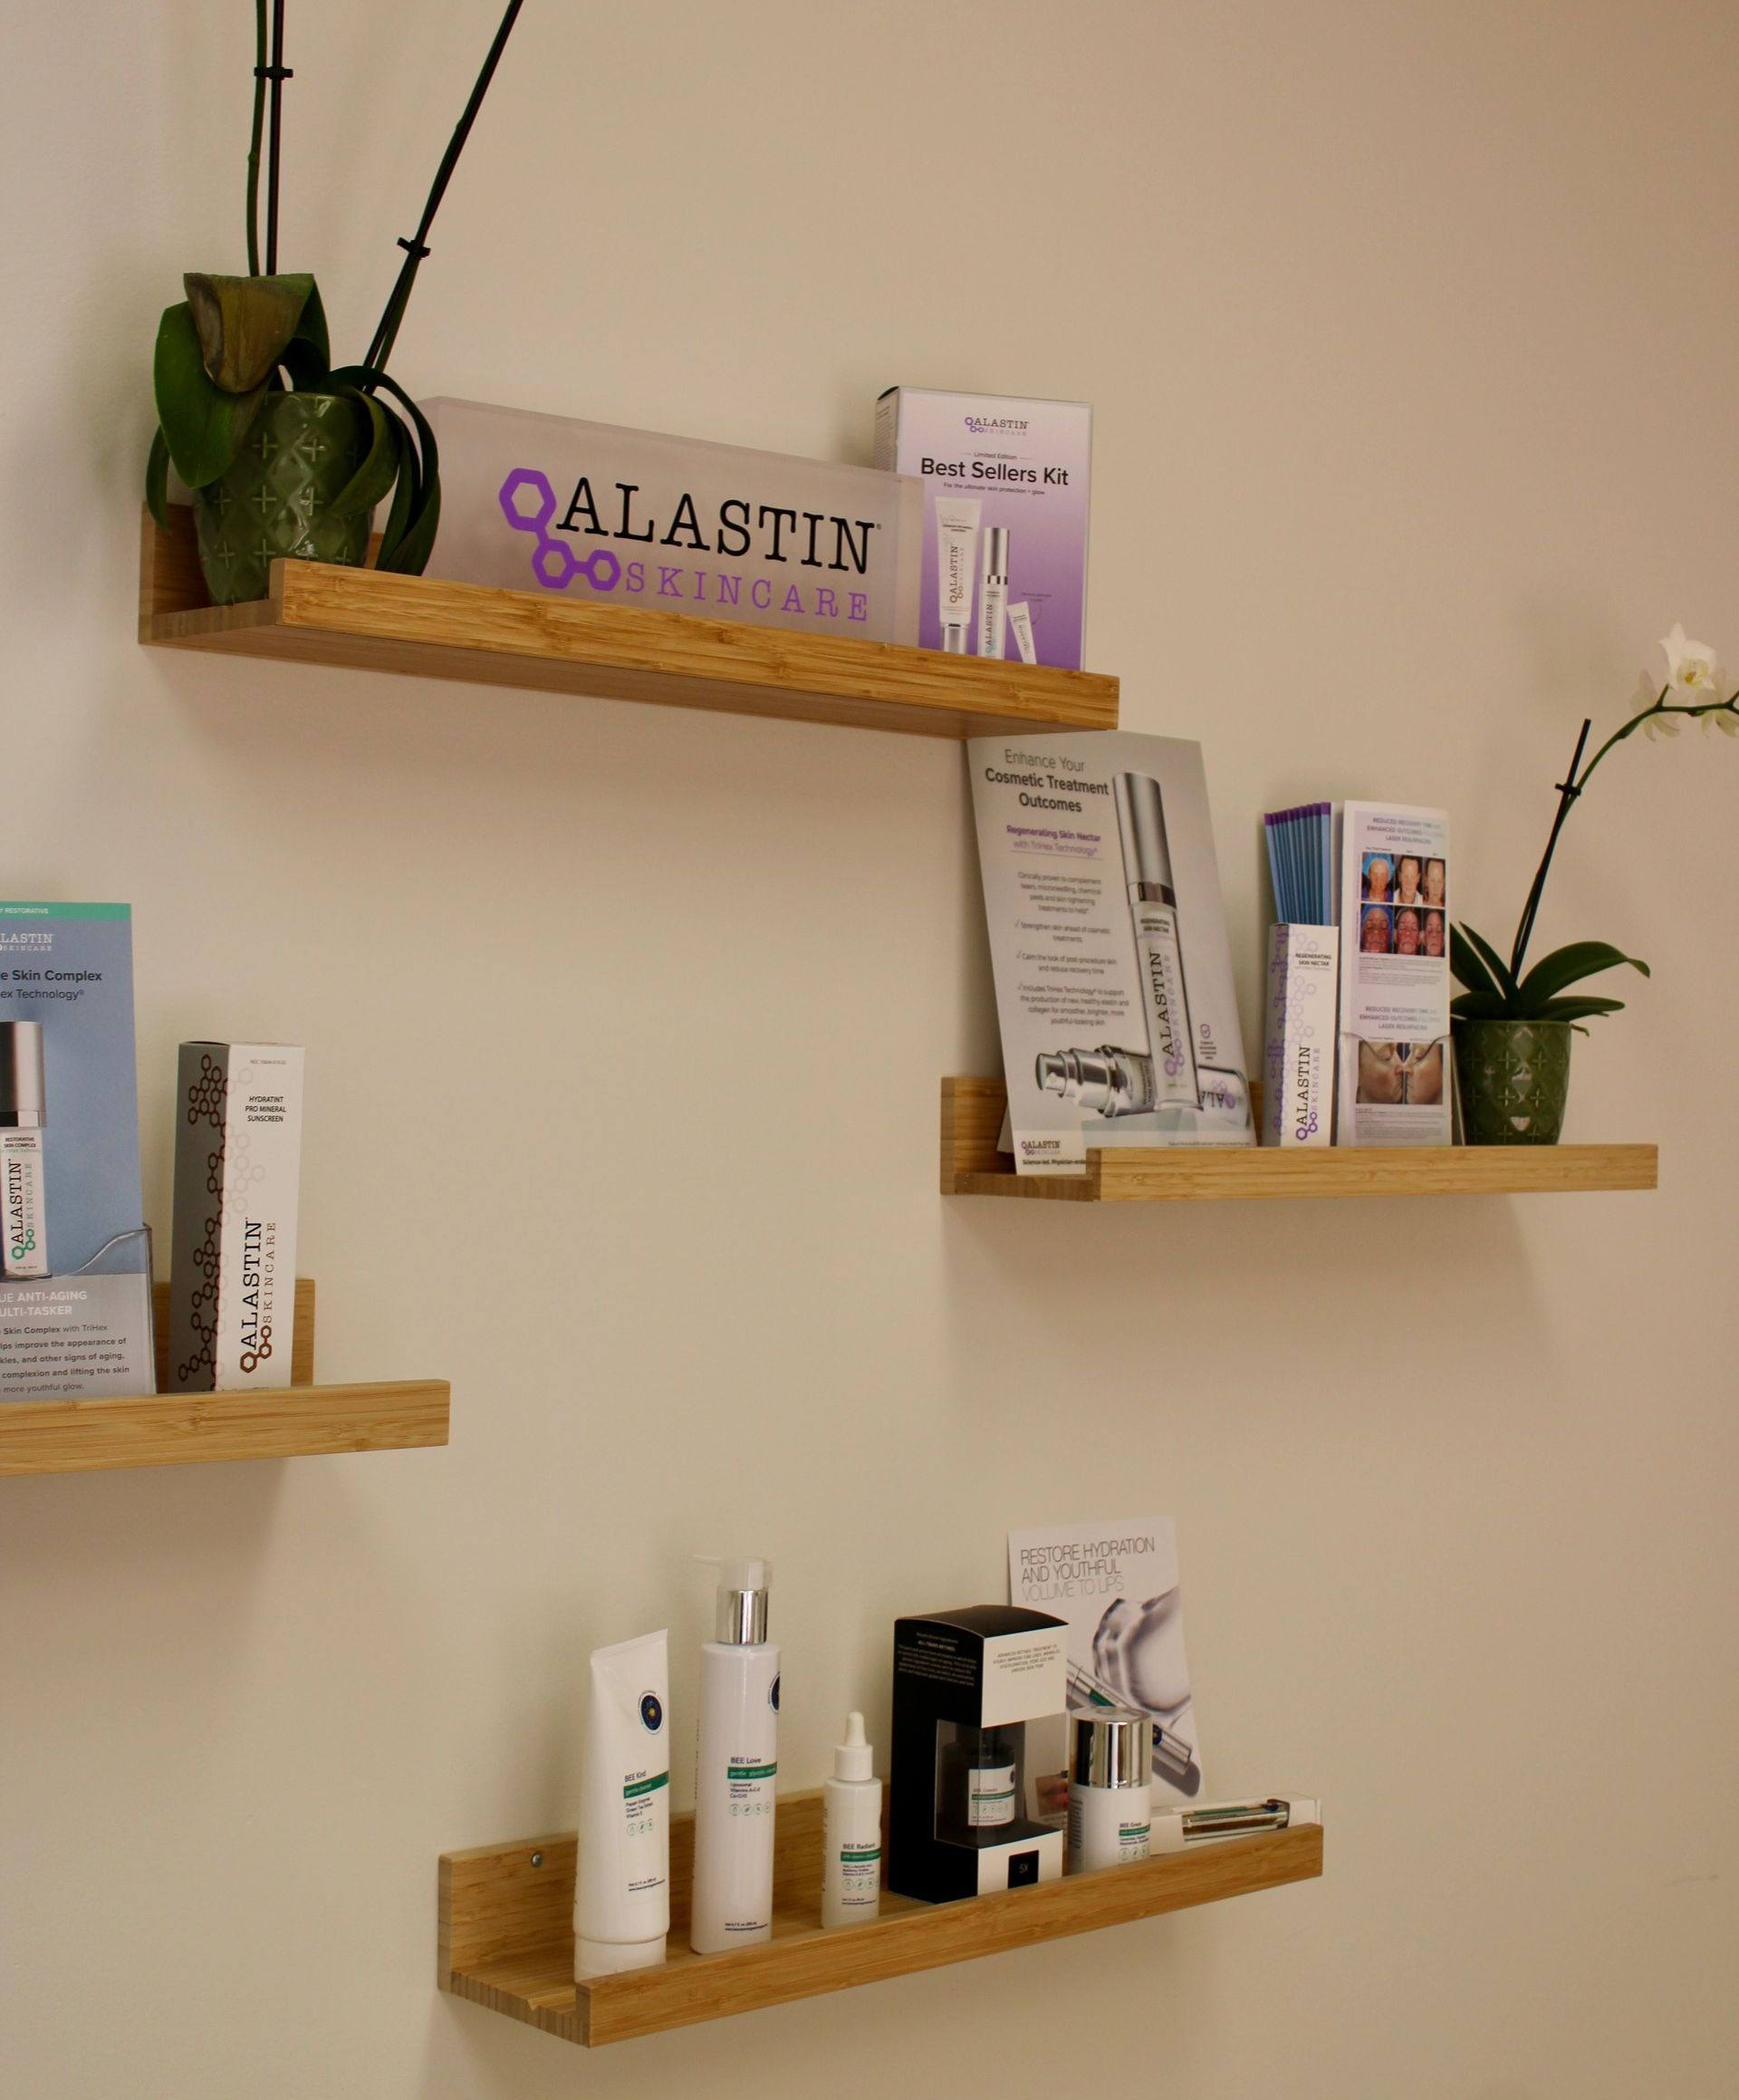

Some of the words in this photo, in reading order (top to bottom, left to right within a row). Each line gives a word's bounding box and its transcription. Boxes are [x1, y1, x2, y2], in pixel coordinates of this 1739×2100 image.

[921, 458, 966, 477] Best
[972, 461, 1037, 483] Sellers
[1043, 467, 1069, 486] Kit
[999, 486, 1026, 495] protection
[625, 561, 868, 622] SKINCARE
[1004, 748, 1056, 769] Enhance
[1058, 756, 1085, 772] Your
[985, 767, 1044, 788] Cosmetic
[1046, 775, 1110, 795] Treatment
[1019, 792, 1082, 813] Outcomes
[1006, 824, 1058, 839] Regenerating
[1059, 830, 1075, 839] Skin
[1076, 832, 1100, 842] Nectar
[12, 969, 41, 981] Skin
[44, 969, 102, 983] Complex
[1148, 951, 1175, 1058] ALASTIN
[1296, 1045, 1311, 1126] ALASTIN
[247, 1114, 283, 1122] SUNSCREEN
[9, 1161, 24, 1245] ALASTIN
[263, 1222, 276, 1324] SKINCARE
[17, 1290, 88, 1302] ANTI-AGING
[241, 1221, 263, 1351] ALASTIN
[24, 1325, 61, 1335] Complex
[62, 1325, 80, 1333] with
[82, 1324, 108, 1332] TriHex
[14, 1341, 49, 1350] improve
[51, 1339, 64, 1347] the
[67, 1338, 116, 1348] appearance
[22, 1355, 37, 1363] and
[40, 1354, 62, 1363] other
[64, 1353, 86, 1363] signs
[2, 1370, 50, 1380] complexion
[70, 1368, 95, 1377] lifting
[96, 1366, 110, 1374] the
[112, 1365, 130, 1373] skin
[27, 1383, 61, 1394] youthful
[1020, 1543, 1081, 1565] RESTORE
[1083, 1536, 1156, 1556] HYDRATION
[1021, 1565, 1051, 1585] AND
[1052, 1557, 1122, 1581] YOUTHFUL
[1022, 1580, 1075, 1603] VOLUME
[1076, 1577, 1097, 1596] TO
[1098, 1575, 1125, 1594] LIPS
[625, 1773, 636, 1782] BEE
